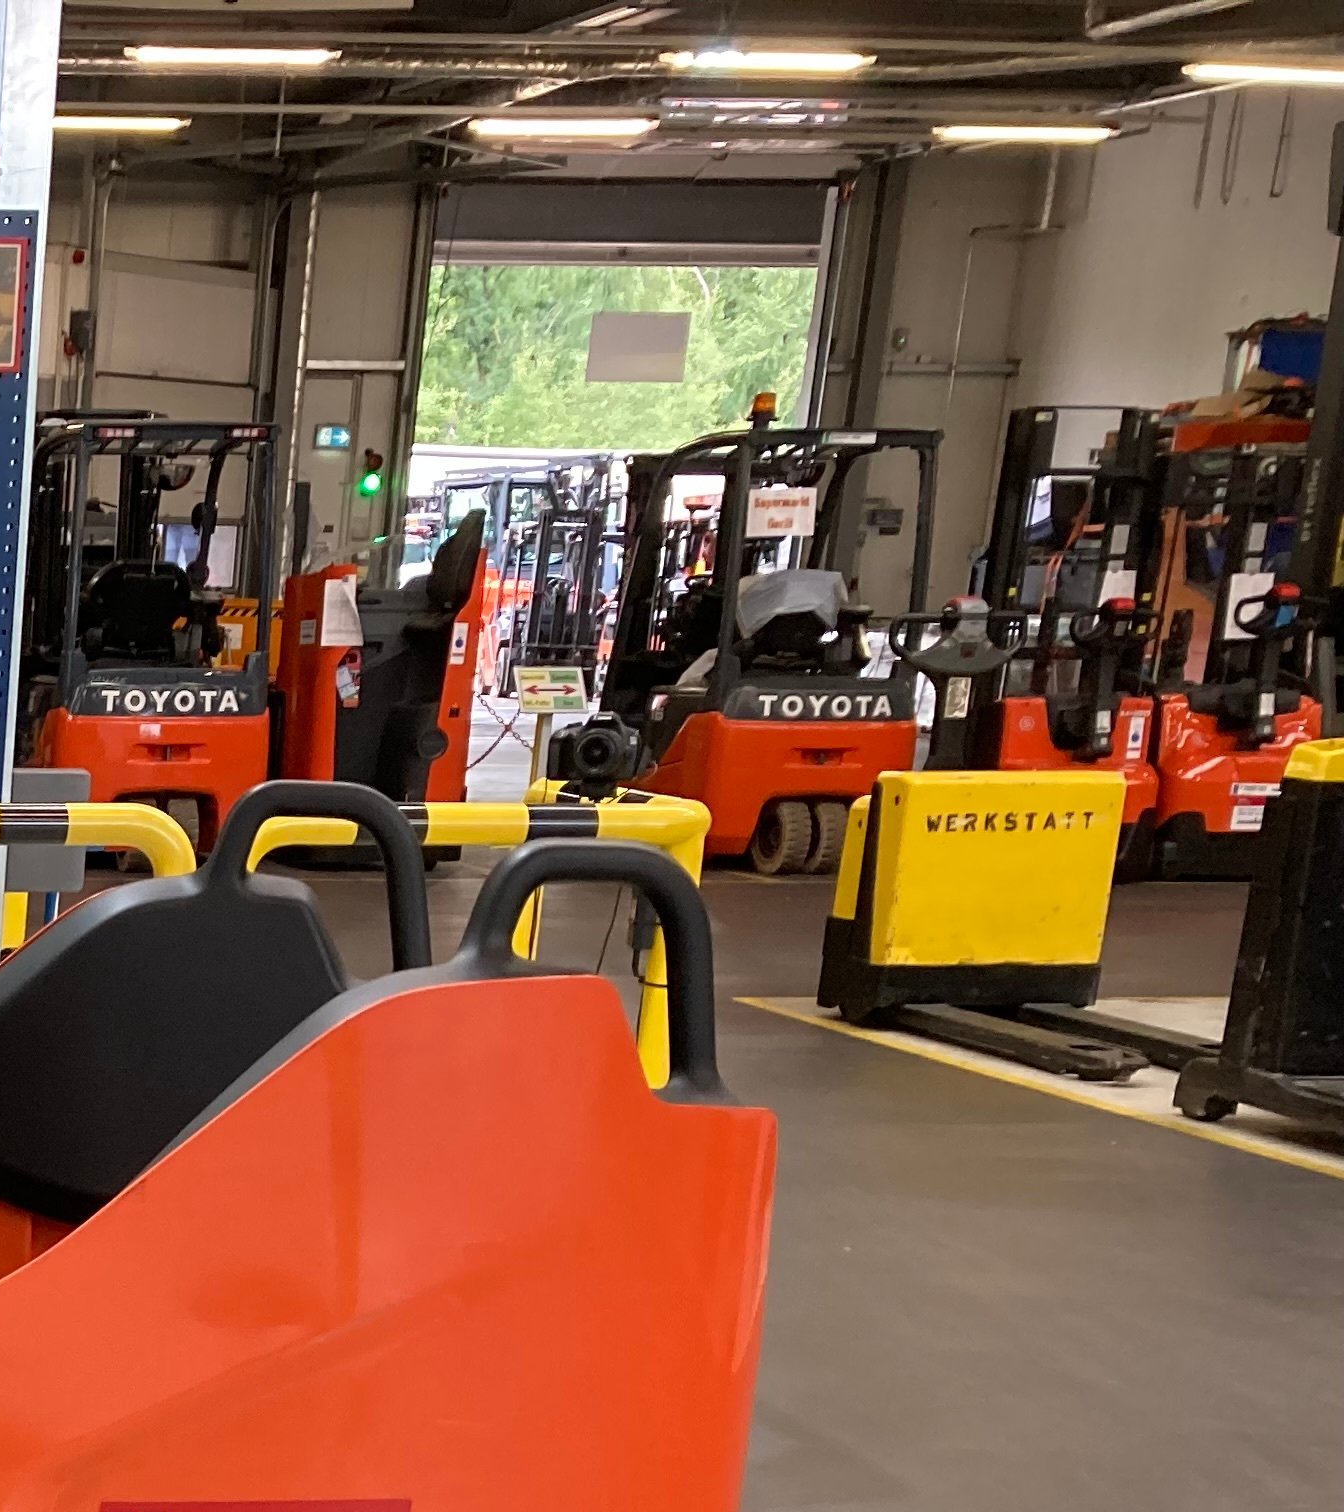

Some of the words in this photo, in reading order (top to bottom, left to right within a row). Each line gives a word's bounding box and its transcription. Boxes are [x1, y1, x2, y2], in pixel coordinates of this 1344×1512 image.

[101, 689, 240, 713] TOYOTA
[758, 694, 893, 718] TOYOTA
[926, 811, 1095, 833] WERKSTATT
